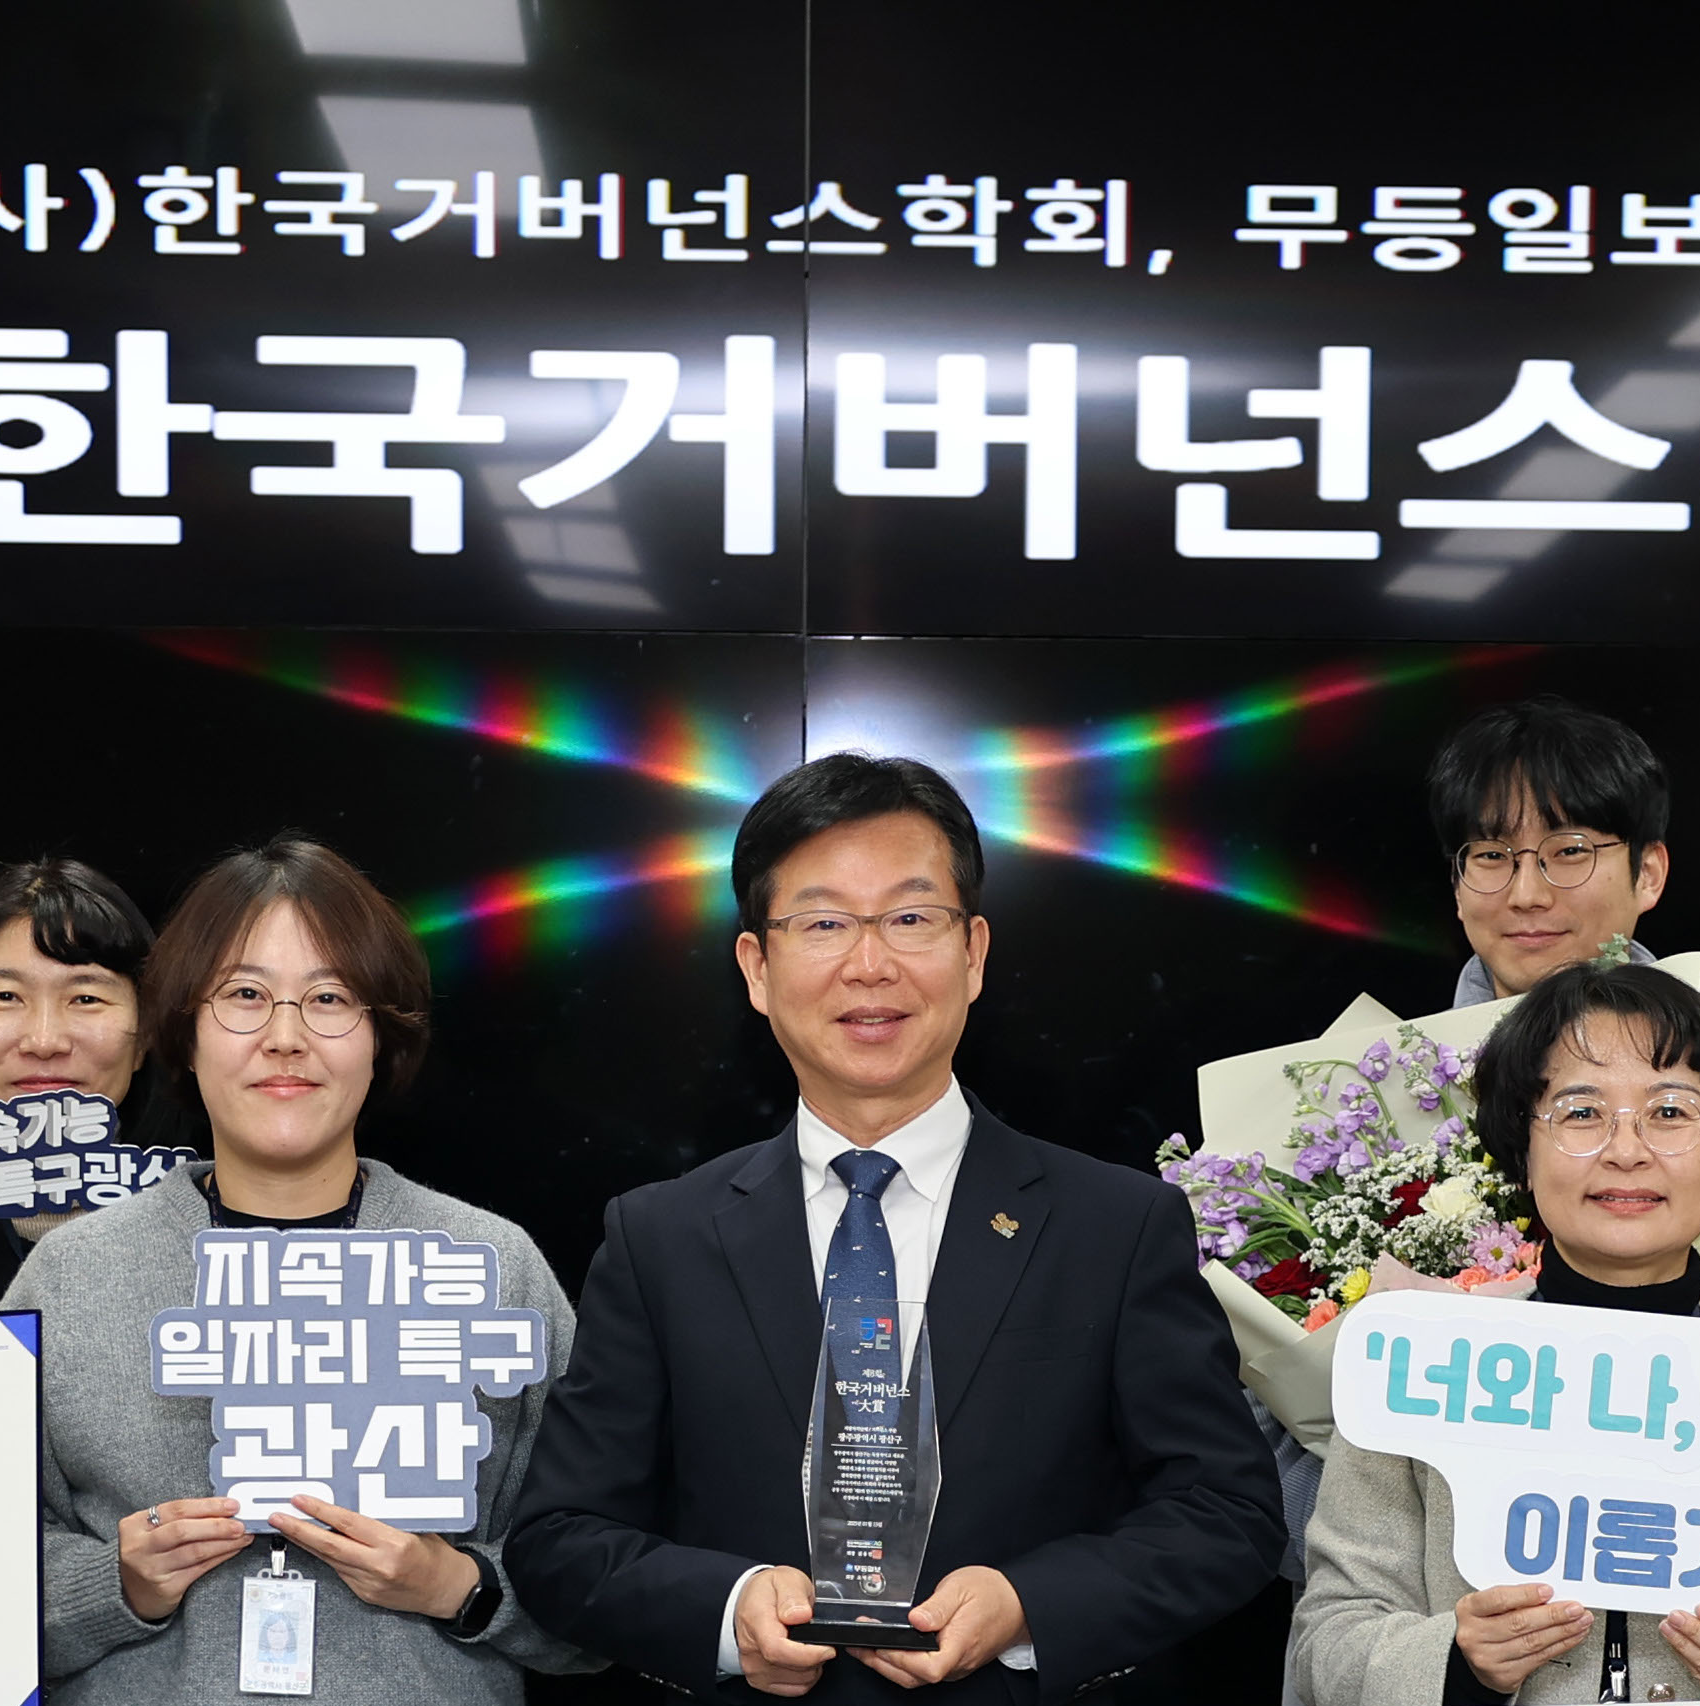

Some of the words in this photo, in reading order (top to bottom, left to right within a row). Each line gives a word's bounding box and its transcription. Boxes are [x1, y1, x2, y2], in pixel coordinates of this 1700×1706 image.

[203, 1239, 487, 1306] 지속가능
[158, 1318, 369, 1386] 일자리
[397, 1319, 535, 1385] 특구
[835, 1380, 911, 1398] 한국거버넌스
[858, 1398, 886, 1414] 大賞
[1588, 1352, 1696, 1453] 나,
[220, 1401, 480, 1521] 광산
